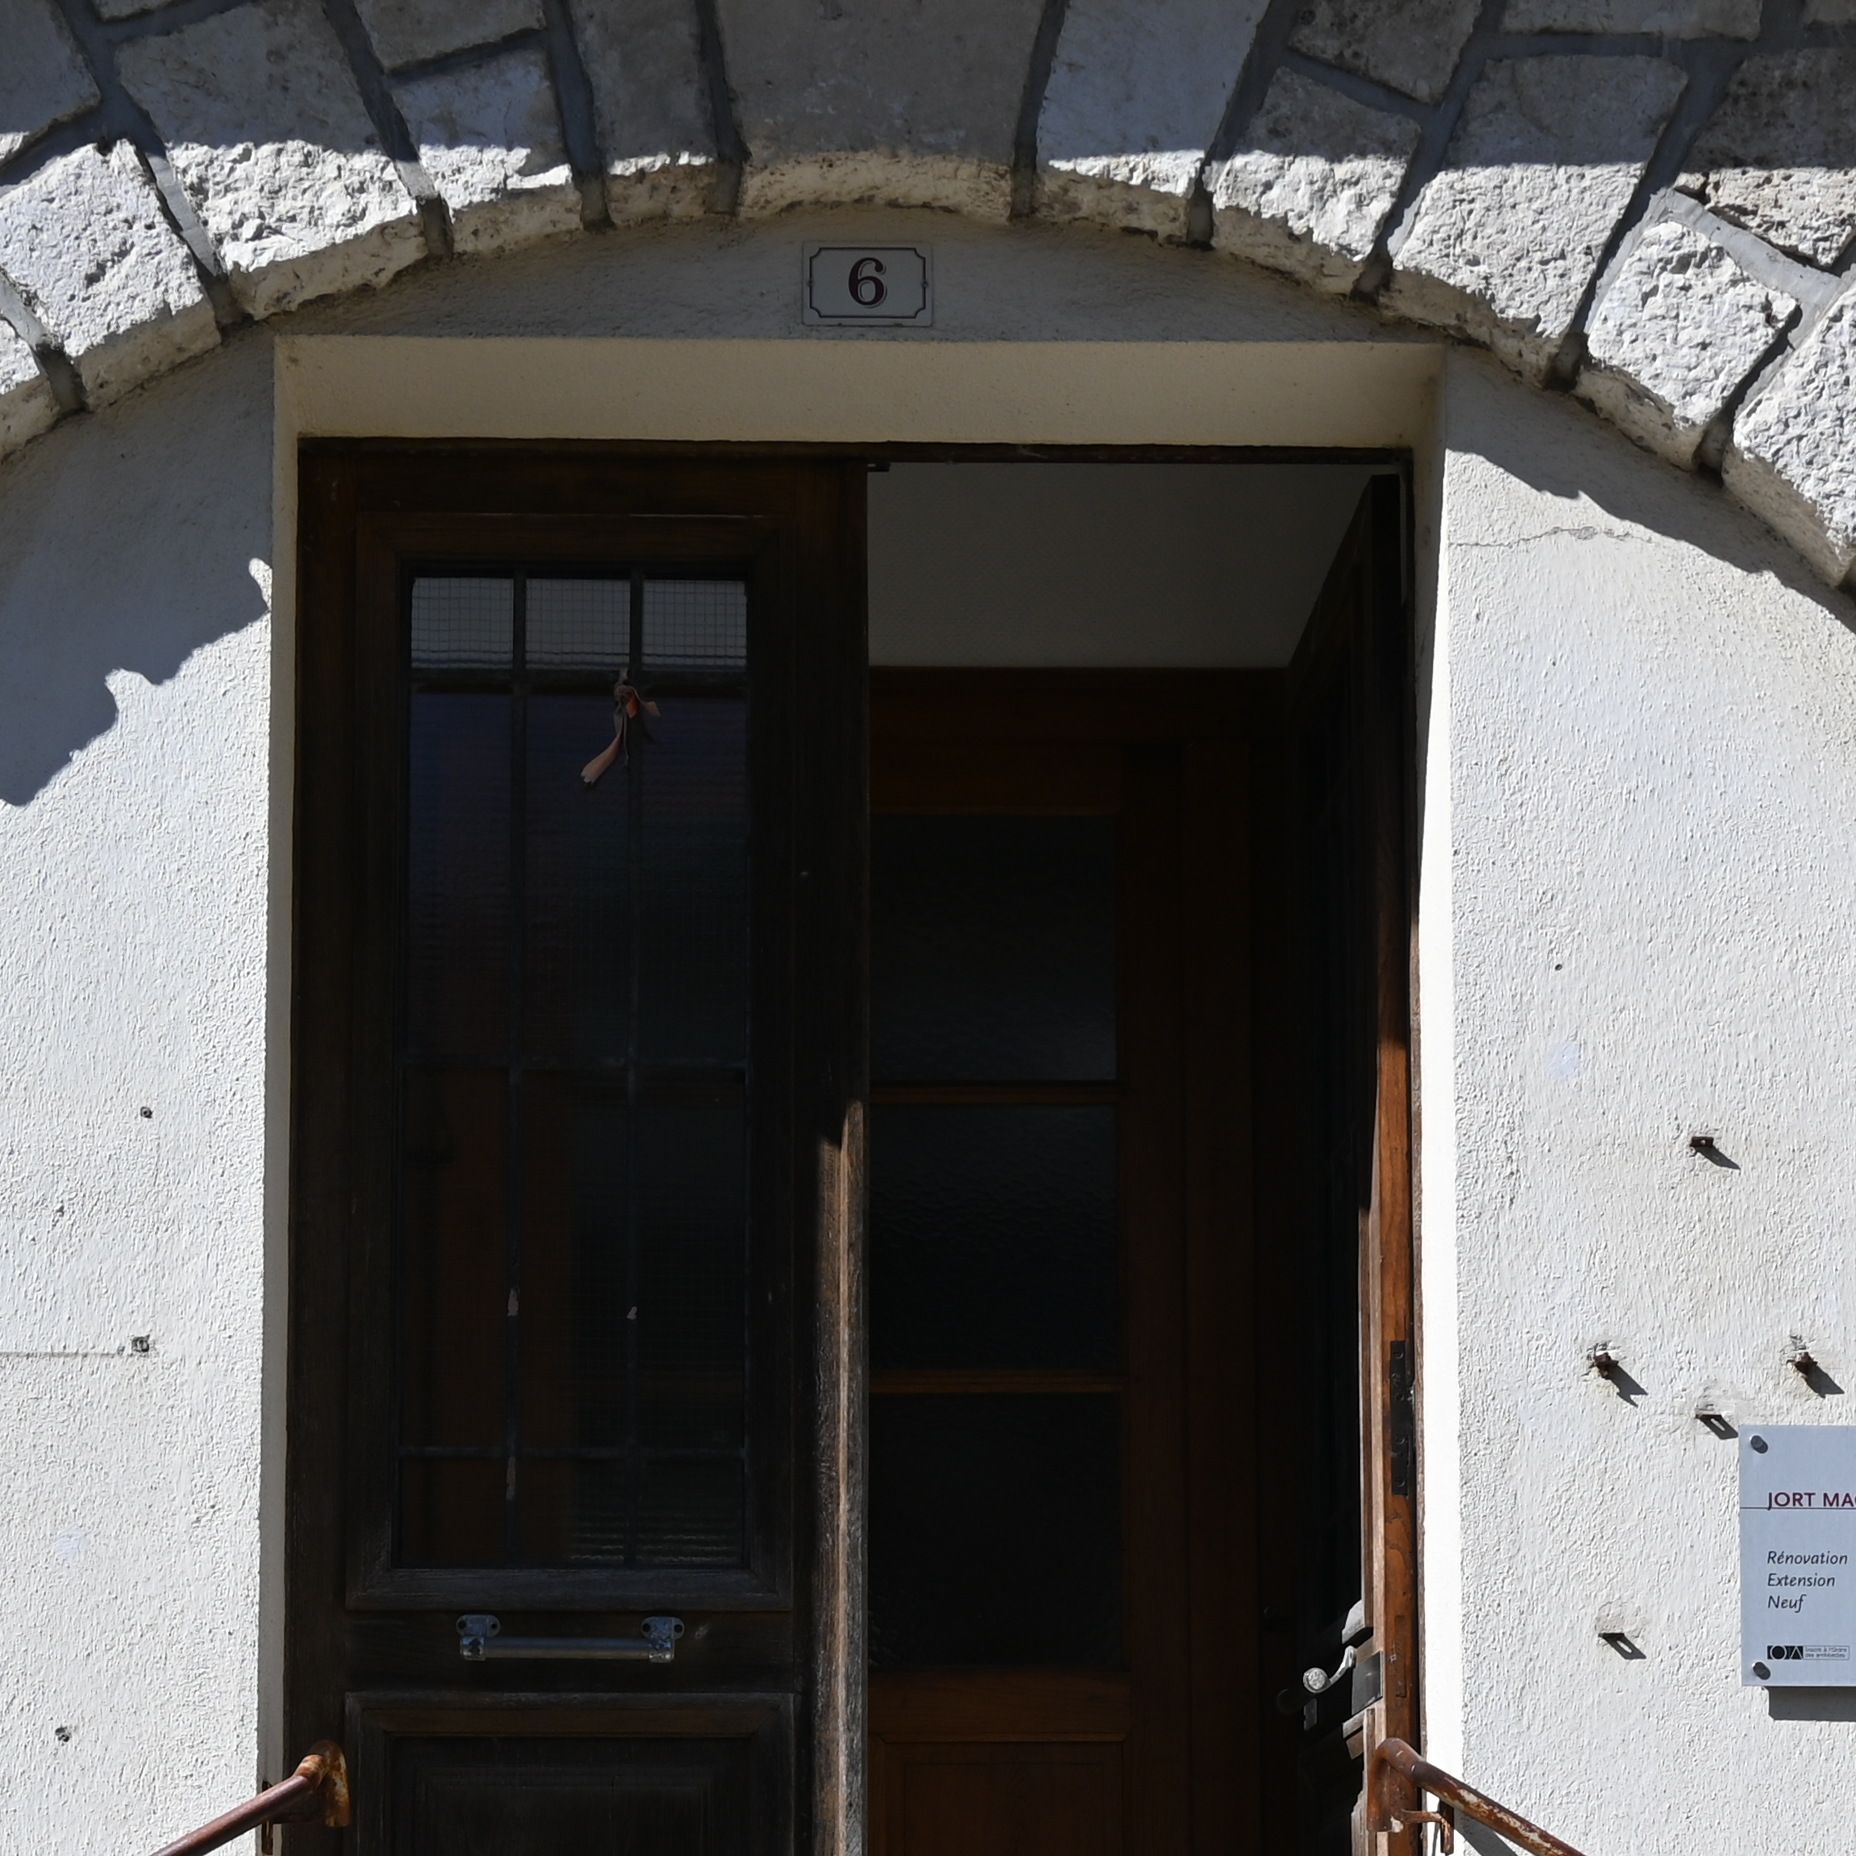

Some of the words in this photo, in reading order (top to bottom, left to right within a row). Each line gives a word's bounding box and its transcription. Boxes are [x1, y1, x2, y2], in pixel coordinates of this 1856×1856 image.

[848, 257, 888, 308] 6
[1767, 1492, 1816, 1511] JORT
[1767, 1550, 1848, 1565] Rénovation
[1767, 1572, 1836, 1587] Extension
[1767, 1594, 1807, 1613] Neuf
